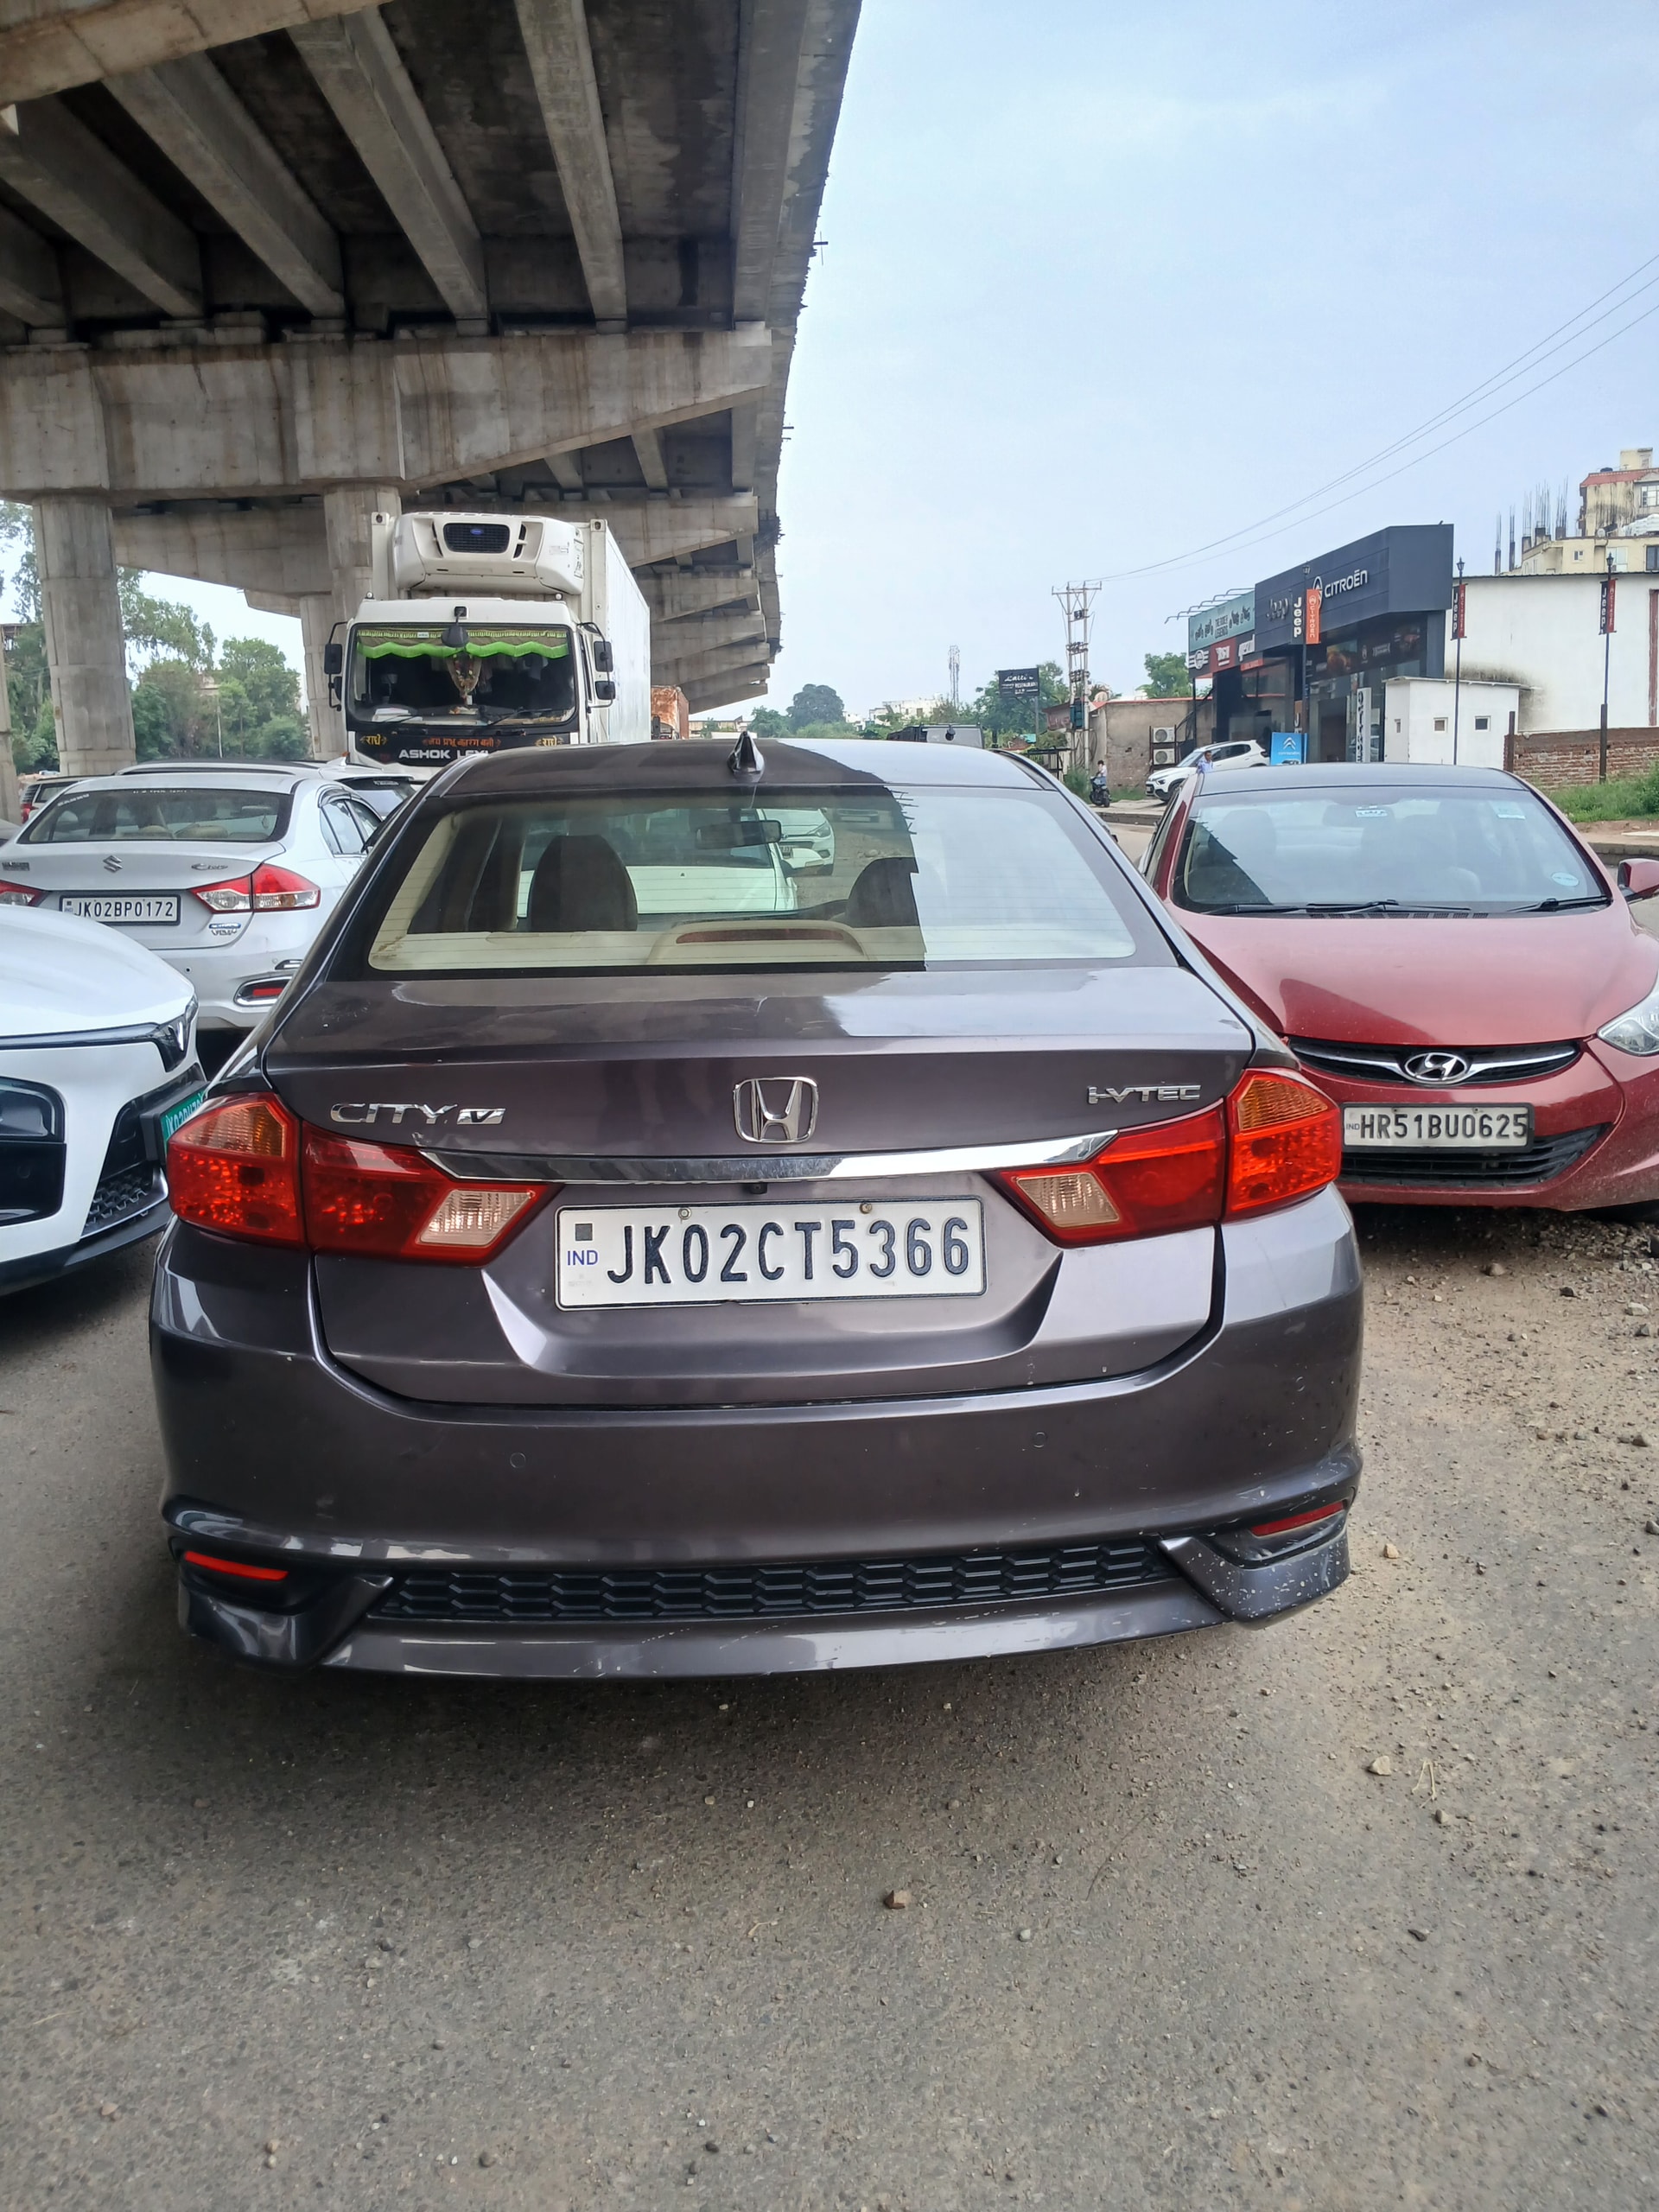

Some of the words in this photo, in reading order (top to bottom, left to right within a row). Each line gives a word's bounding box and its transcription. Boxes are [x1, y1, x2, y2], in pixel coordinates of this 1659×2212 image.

[1294, 596, 1302, 638] Jeep
[398, 749, 451, 760] ASHOK
[74, 901, 174, 918] JK02BP0172
[331, 1103, 458, 1124] CITY
[1359, 1113, 1528, 1140] HR51BU0625
[567, 1249, 598, 1266] IND
[607, 1217, 970, 1285] JK02CT5366
